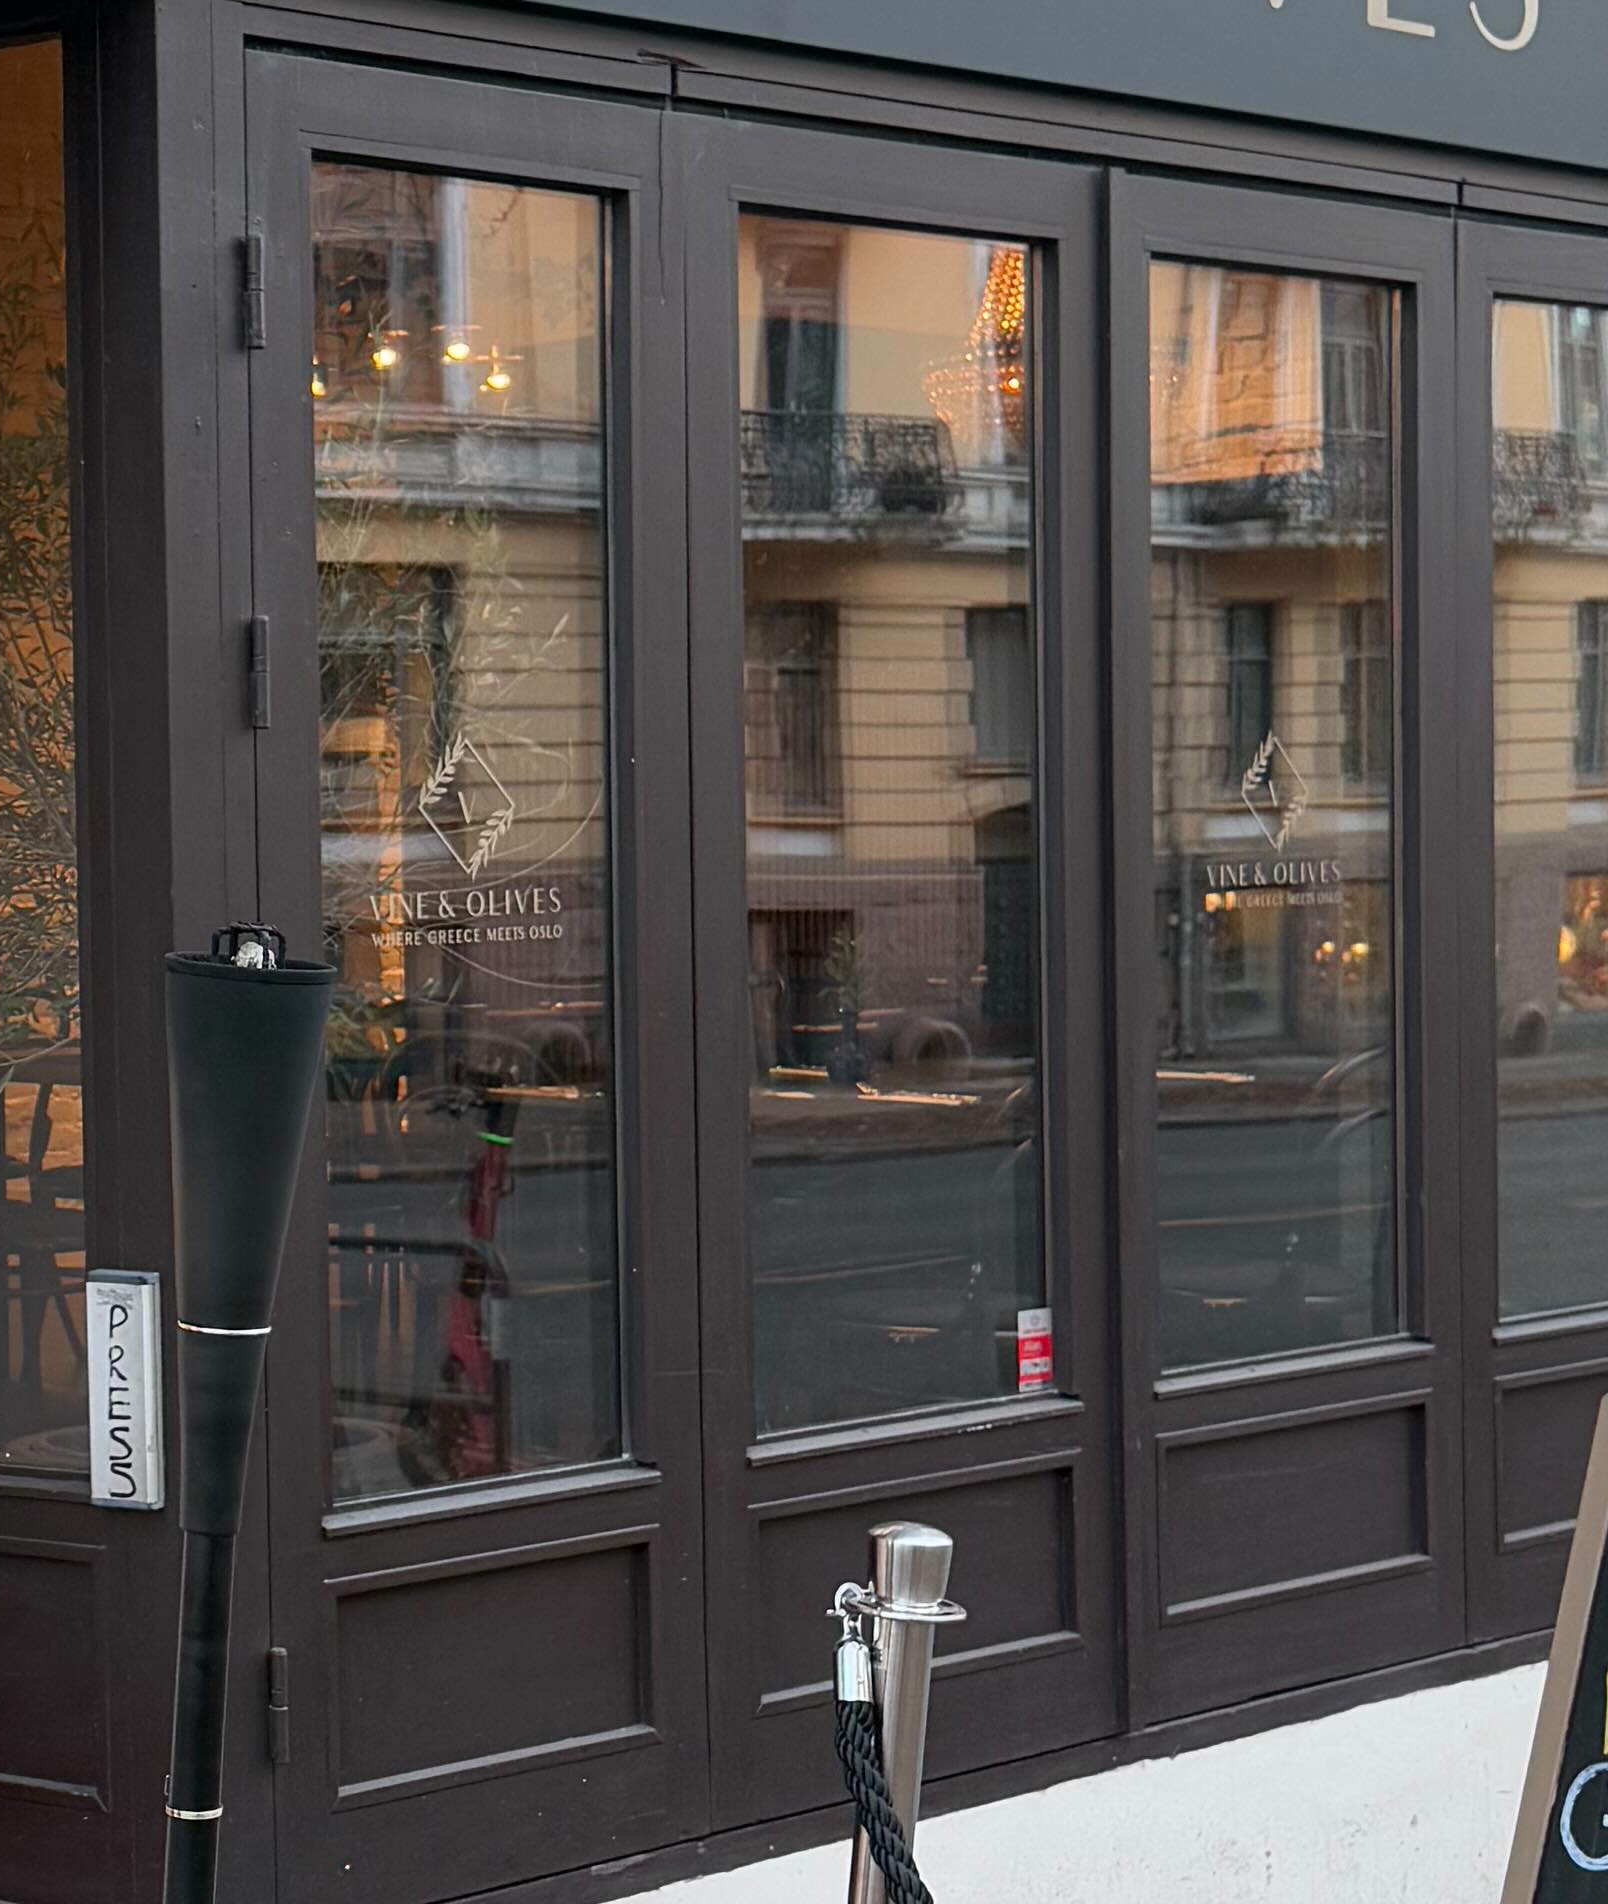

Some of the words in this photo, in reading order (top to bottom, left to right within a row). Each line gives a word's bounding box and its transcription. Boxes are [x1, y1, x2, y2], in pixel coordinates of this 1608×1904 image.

[457, 791, 476, 824] V
[1205, 862, 1248, 888] VINE
[1254, 861, 1267, 886] &
[1273, 859, 1342, 885] OLIVES
[369, 891, 429, 921] VINE
[437, 889, 456, 918] &
[466, 886, 562, 917] OLIVES
[371, 930, 422, 948] WHERE
[427, 927, 481, 945] GREECE
[486, 925, 525, 942] MEETS
[529, 923, 563, 940] OSLO
[107, 1303, 137, 1499] PRESS
